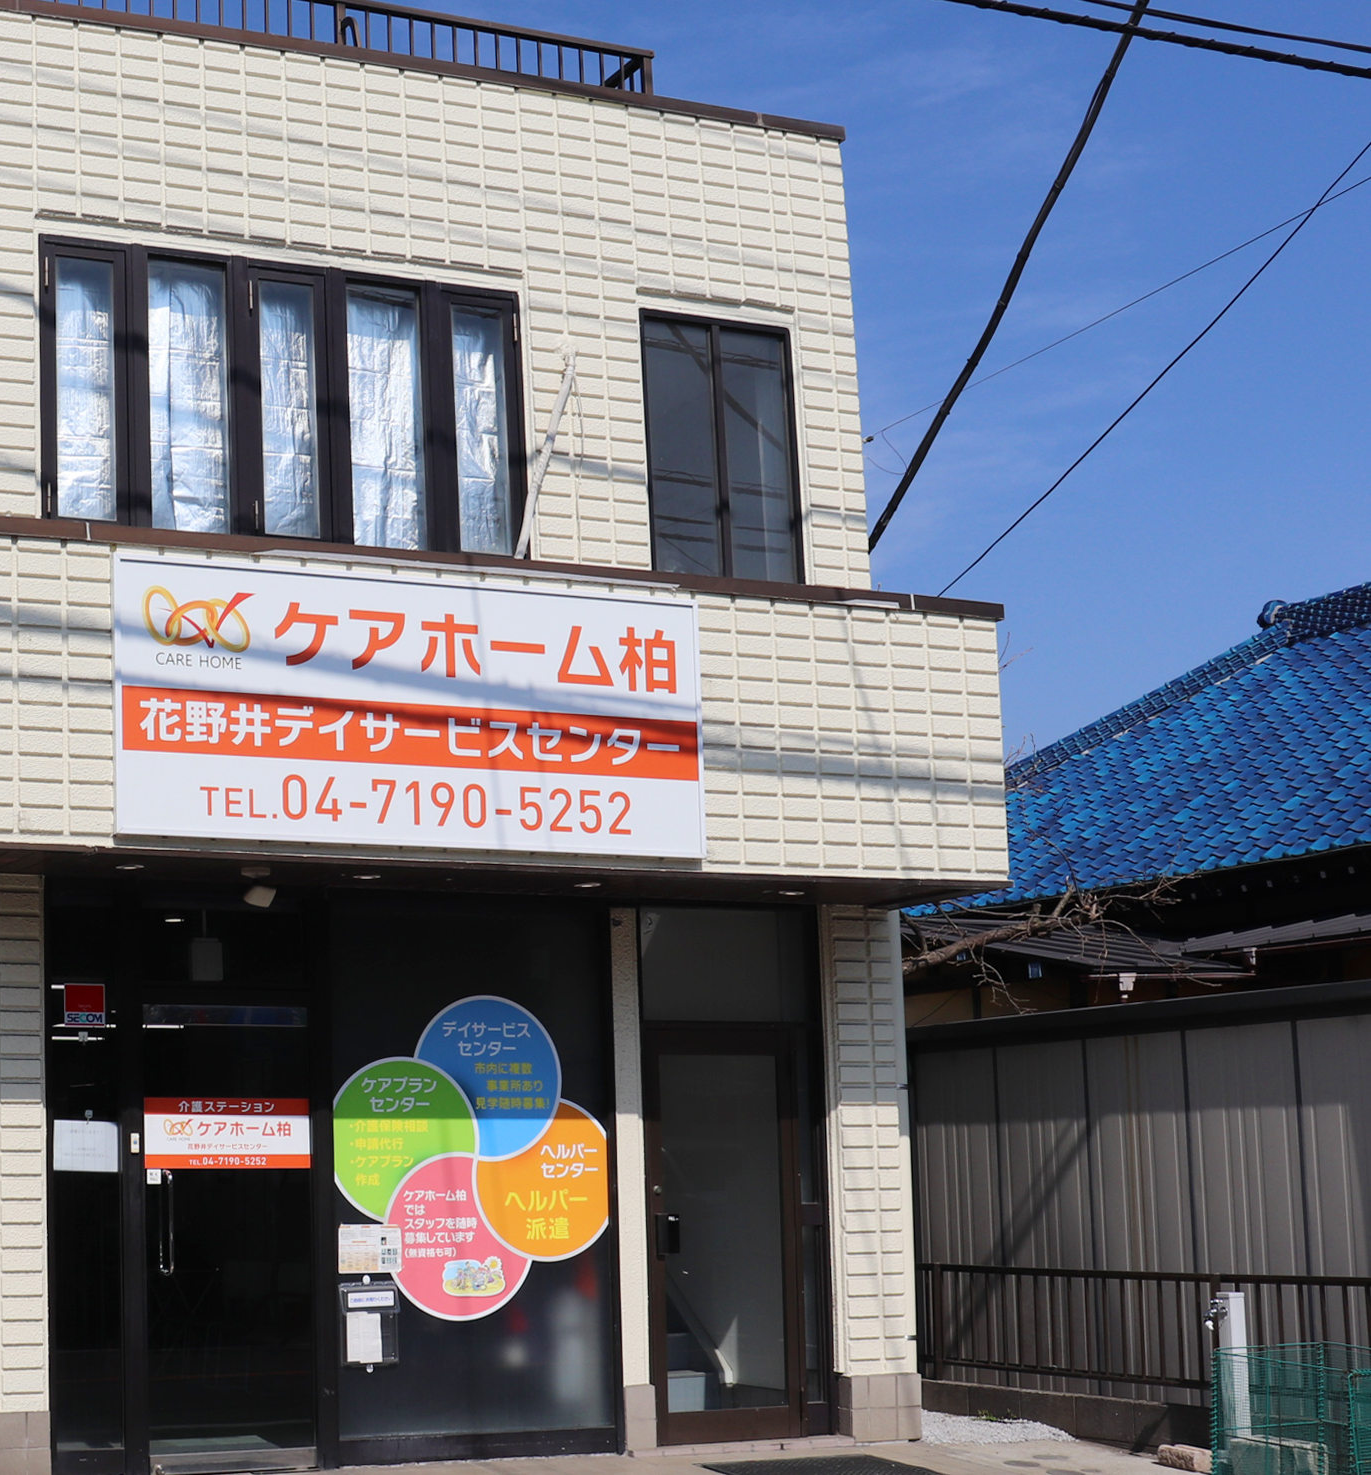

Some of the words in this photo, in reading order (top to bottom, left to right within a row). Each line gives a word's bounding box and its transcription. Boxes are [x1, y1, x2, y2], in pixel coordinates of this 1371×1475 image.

[274, 601, 677, 694] ケアホーム柏
[155, 652, 192, 667] CARE
[199, 654, 242, 670] HOME
[139, 697, 680, 766] 花野井デイサービスセンター
[199, 774, 631, 835] TEL.04-7190-5252
[67, 1013, 103, 1023] SECOM
[442, 1021, 531, 1038] デイサービス
[458, 1040, 516, 1057] センター
[361, 1077, 438, 1093] ケアプラン
[486, 1080, 543, 1092] 事業所あり
[178, 1101, 275, 1113] 介護ステーション
[369, 1097, 430, 1112] センター
[197, 1120, 291, 1137] ケアホーム柏
[540, 1143, 598, 1160] ヘルパー
[540, 1162, 599, 1178] センター
[355, 1173, 380, 1186] 作成
[403, 1189, 467, 1202] ケアホーム柏
[505, 1188, 588, 1212] ヘルパー
[404, 1204, 426, 1216] では
[404, 1217, 477, 1230] スタッフを随時
[525, 1217, 570, 1240] 派遣
[404, 1231, 475, 1243] 募集しています
